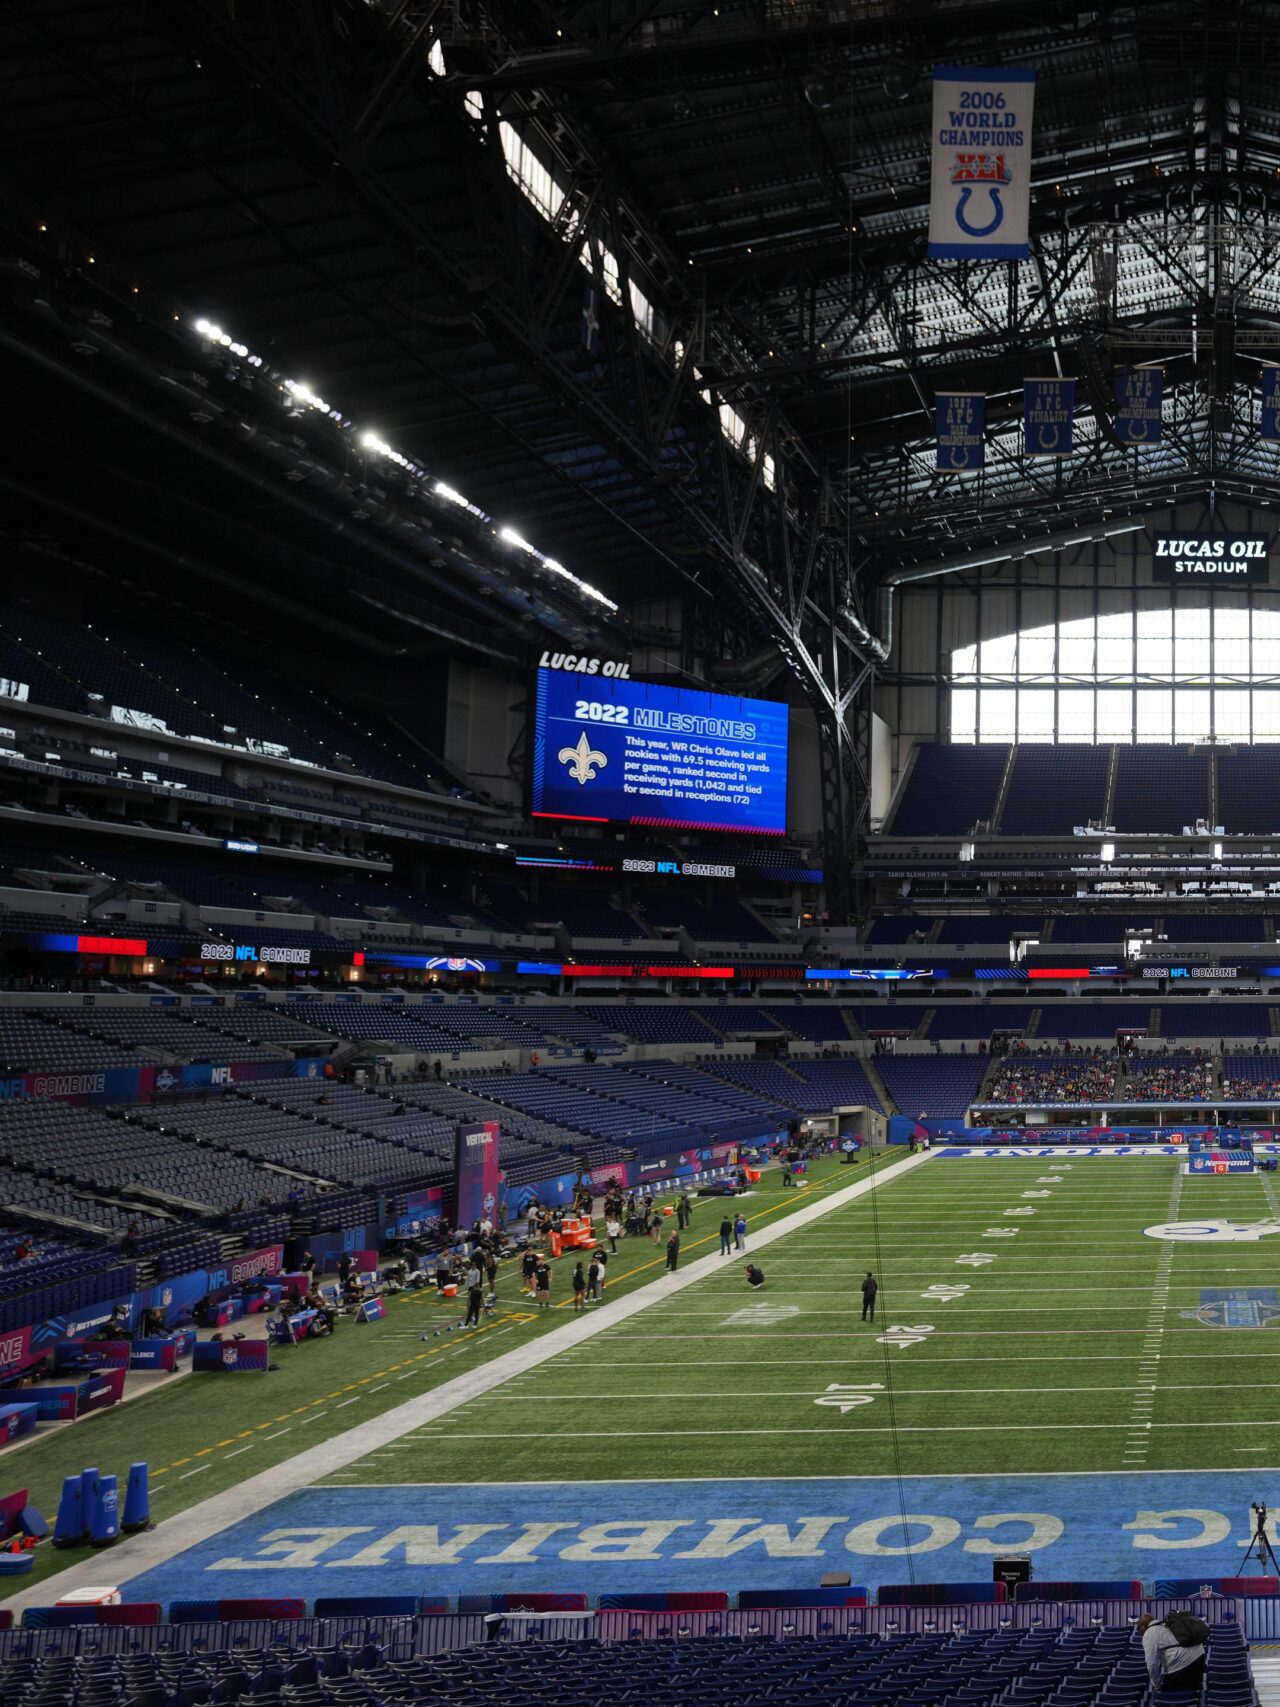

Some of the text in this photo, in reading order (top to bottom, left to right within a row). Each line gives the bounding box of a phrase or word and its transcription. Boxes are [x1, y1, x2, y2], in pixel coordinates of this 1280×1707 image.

[960, 91, 1006, 109] 2006
[949, 112, 1016, 128] WORLD
[940, 129, 1024, 146] CHAMPIONS
[952, 153, 1008, 180] XLI
[1125, 382, 1152, 397] AFC
[1035, 397, 1062, 410] AFC
[946, 410, 974, 424] AFC
[1029, 410, 1069, 423] FINALIST
[1118, 407, 1160, 419] CHAMPIONS
[939, 435, 980, 446] CHAMPIONS
[1156, 540, 1267, 558] LUCAS OIL
[1175, 561, 1248, 573] STADIUM
[538, 651, 630, 680] LUCAS OIL
[575, 700, 756, 740] 2022 MILESTONES
[626, 736, 766, 761] This year, WR Chris Olave led all
[625, 749, 770, 773] rookies with 69.5 receiving yards
[624, 761, 747, 781] per game, ranked second in
[624, 773, 762, 794] receiving yards (1,042) and tied
[624, 784, 750, 805] for second in receptions (72)
[622, 860, 735, 877] 2023 NFL COMBINE
[201, 943, 310, 964] 2023 NFL COMBINE
[1143, 967, 1237, 978] 2023 NFL COMBINE
[211, 1066, 235, 1084] NFL
[0, 1074, 106, 1098] NFL COMBINE
[466, 1131, 493, 1146] VERTICAL
[208, 1252, 276, 1292] NFL COMBINE
[921, 1284, 972, 1299] 30
[875, 1325, 936, 1344] 20
[814, 1383, 886, 1407] 10
[204, 1512, 1066, 1572] COMBINE
